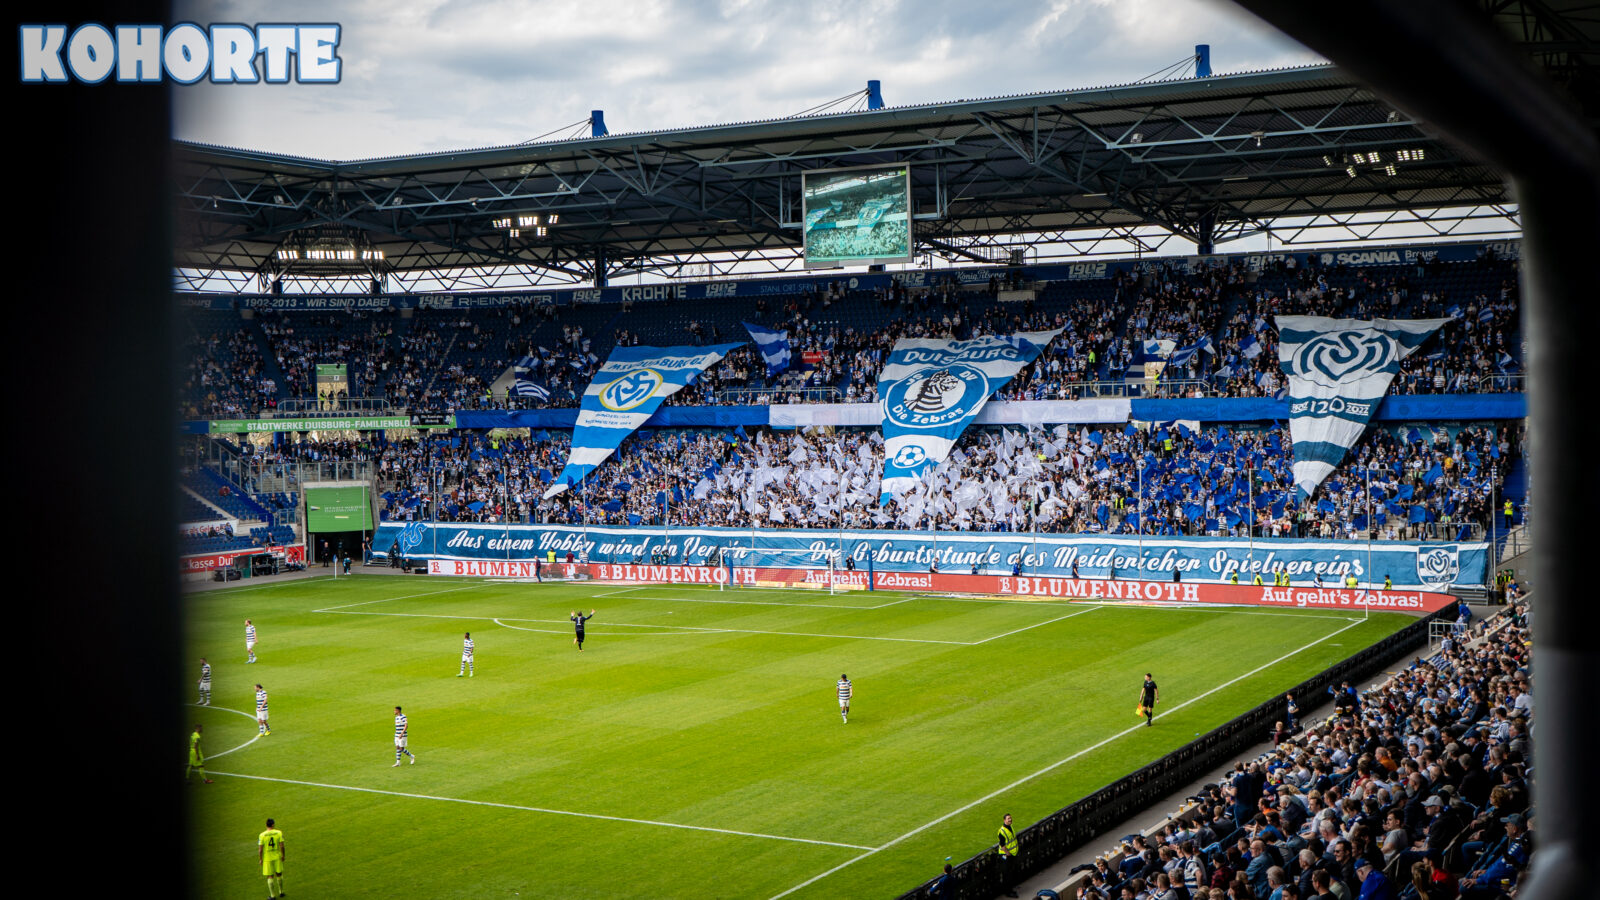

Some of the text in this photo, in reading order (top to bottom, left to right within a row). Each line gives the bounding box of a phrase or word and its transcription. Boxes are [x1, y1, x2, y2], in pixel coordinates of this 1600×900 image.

[1337, 251, 1400, 264] SCANIA
[458, 295, 552, 306] RHEINPOWER
[622, 285, 687, 300] KROHNE
[245, 298, 297, 308] 1902-2013
[306, 298, 327, 308] WIR
[329, 298, 355, 307] SIND
[358, 298, 390, 307] DABEI
[902, 348, 1019, 364] DUISBURG
[1310, 397, 1346, 414] 120
[892, 404, 964, 424] Die Zebras
[247, 421, 304, 431] STADTWERKE
[305, 419, 410, 430] DUISBURG-FAMILIENBLO
[189, 556, 235, 569] kasse Dui
[447, 530, 484, 549] Aus
[488, 533, 534, 550] einem
[535, 531, 595, 554] Hobby
[651, 537, 679, 557] ein
[809, 540, 842, 562] Die
[853, 541, 1000, 565] Geburtsstunde
[1007, 545, 1048, 568] des
[1053, 546, 1201, 573] Meidericher
[1208, 549, 1364, 581] Spielvereins
[612, 565, 757, 584] BLUMENROTH
[804, 570, 832, 584] Auf
[877, 572, 932, 588] Zebras!
[1016, 577, 1200, 602] BLUMENROTH
[1261, 587, 1424, 608] Auf geht's Zebras!
[268, 837, 275, 848] 4
